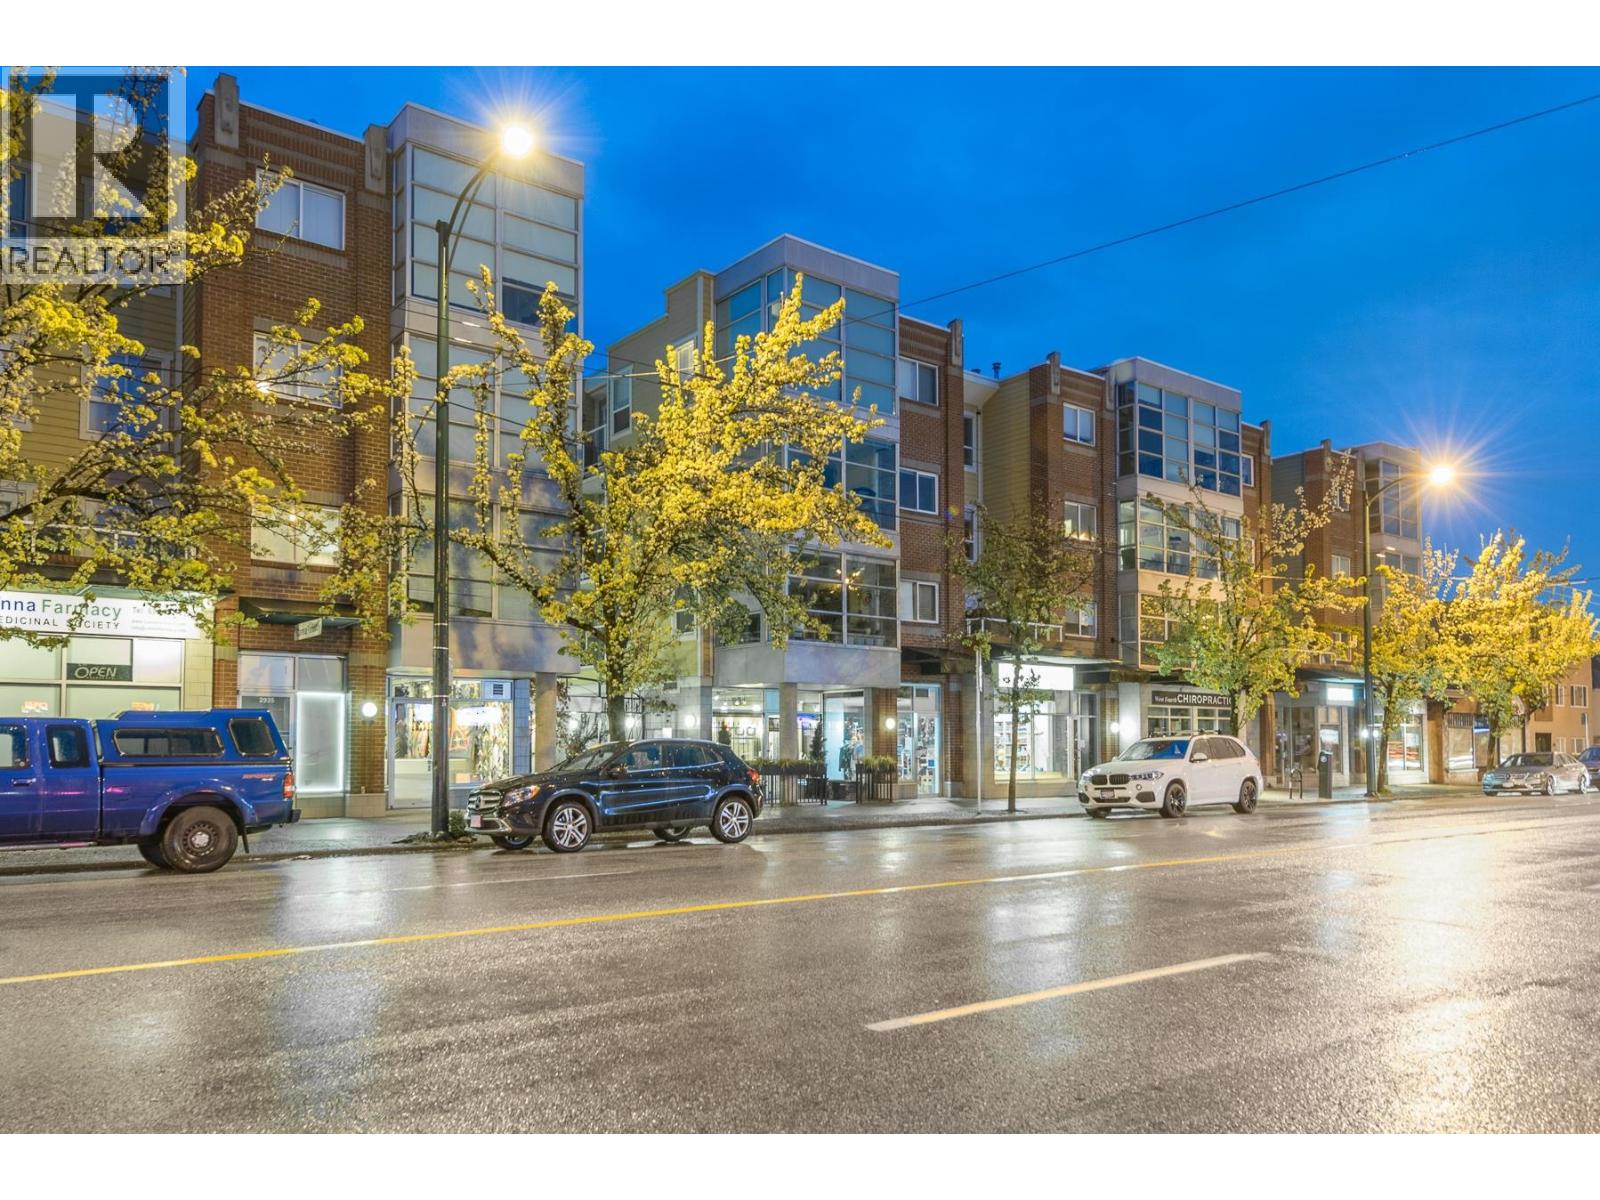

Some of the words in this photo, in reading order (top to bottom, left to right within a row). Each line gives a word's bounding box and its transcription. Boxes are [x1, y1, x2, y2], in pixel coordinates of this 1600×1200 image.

[42, 599, 122, 621] Farmacy
[68, 619, 120, 630] CIETY
[74, 666, 117, 679] OPEN
